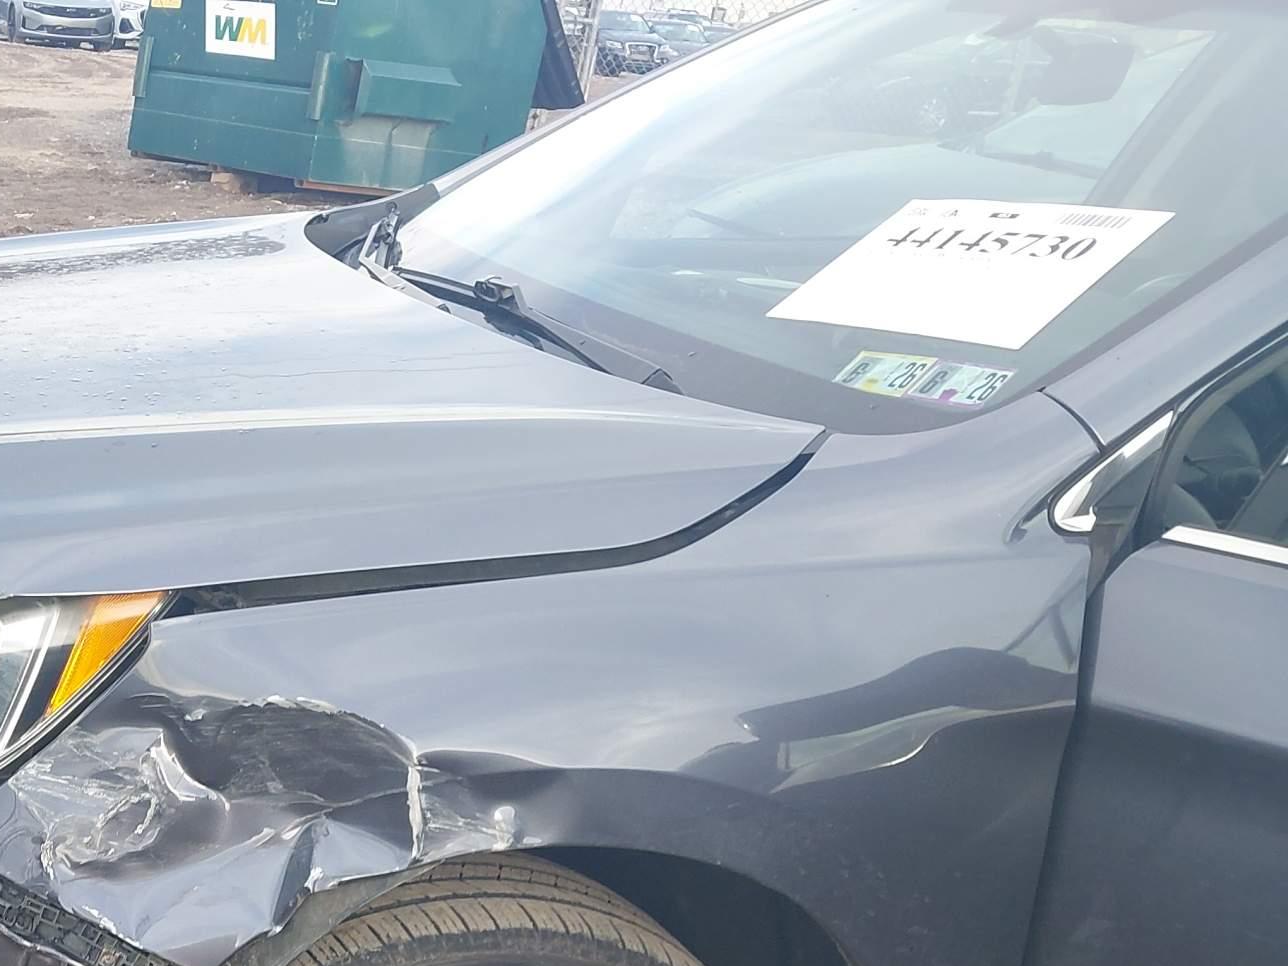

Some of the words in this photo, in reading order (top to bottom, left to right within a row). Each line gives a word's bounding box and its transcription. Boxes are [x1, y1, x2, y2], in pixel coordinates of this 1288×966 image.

[215, 14, 267, 45] WM
[887, 226, 1098, 260] 44145730
[888, 362, 928, 389] 26
[919, 370, 949, 394] 6
[966, 372, 1008, 400] 26
